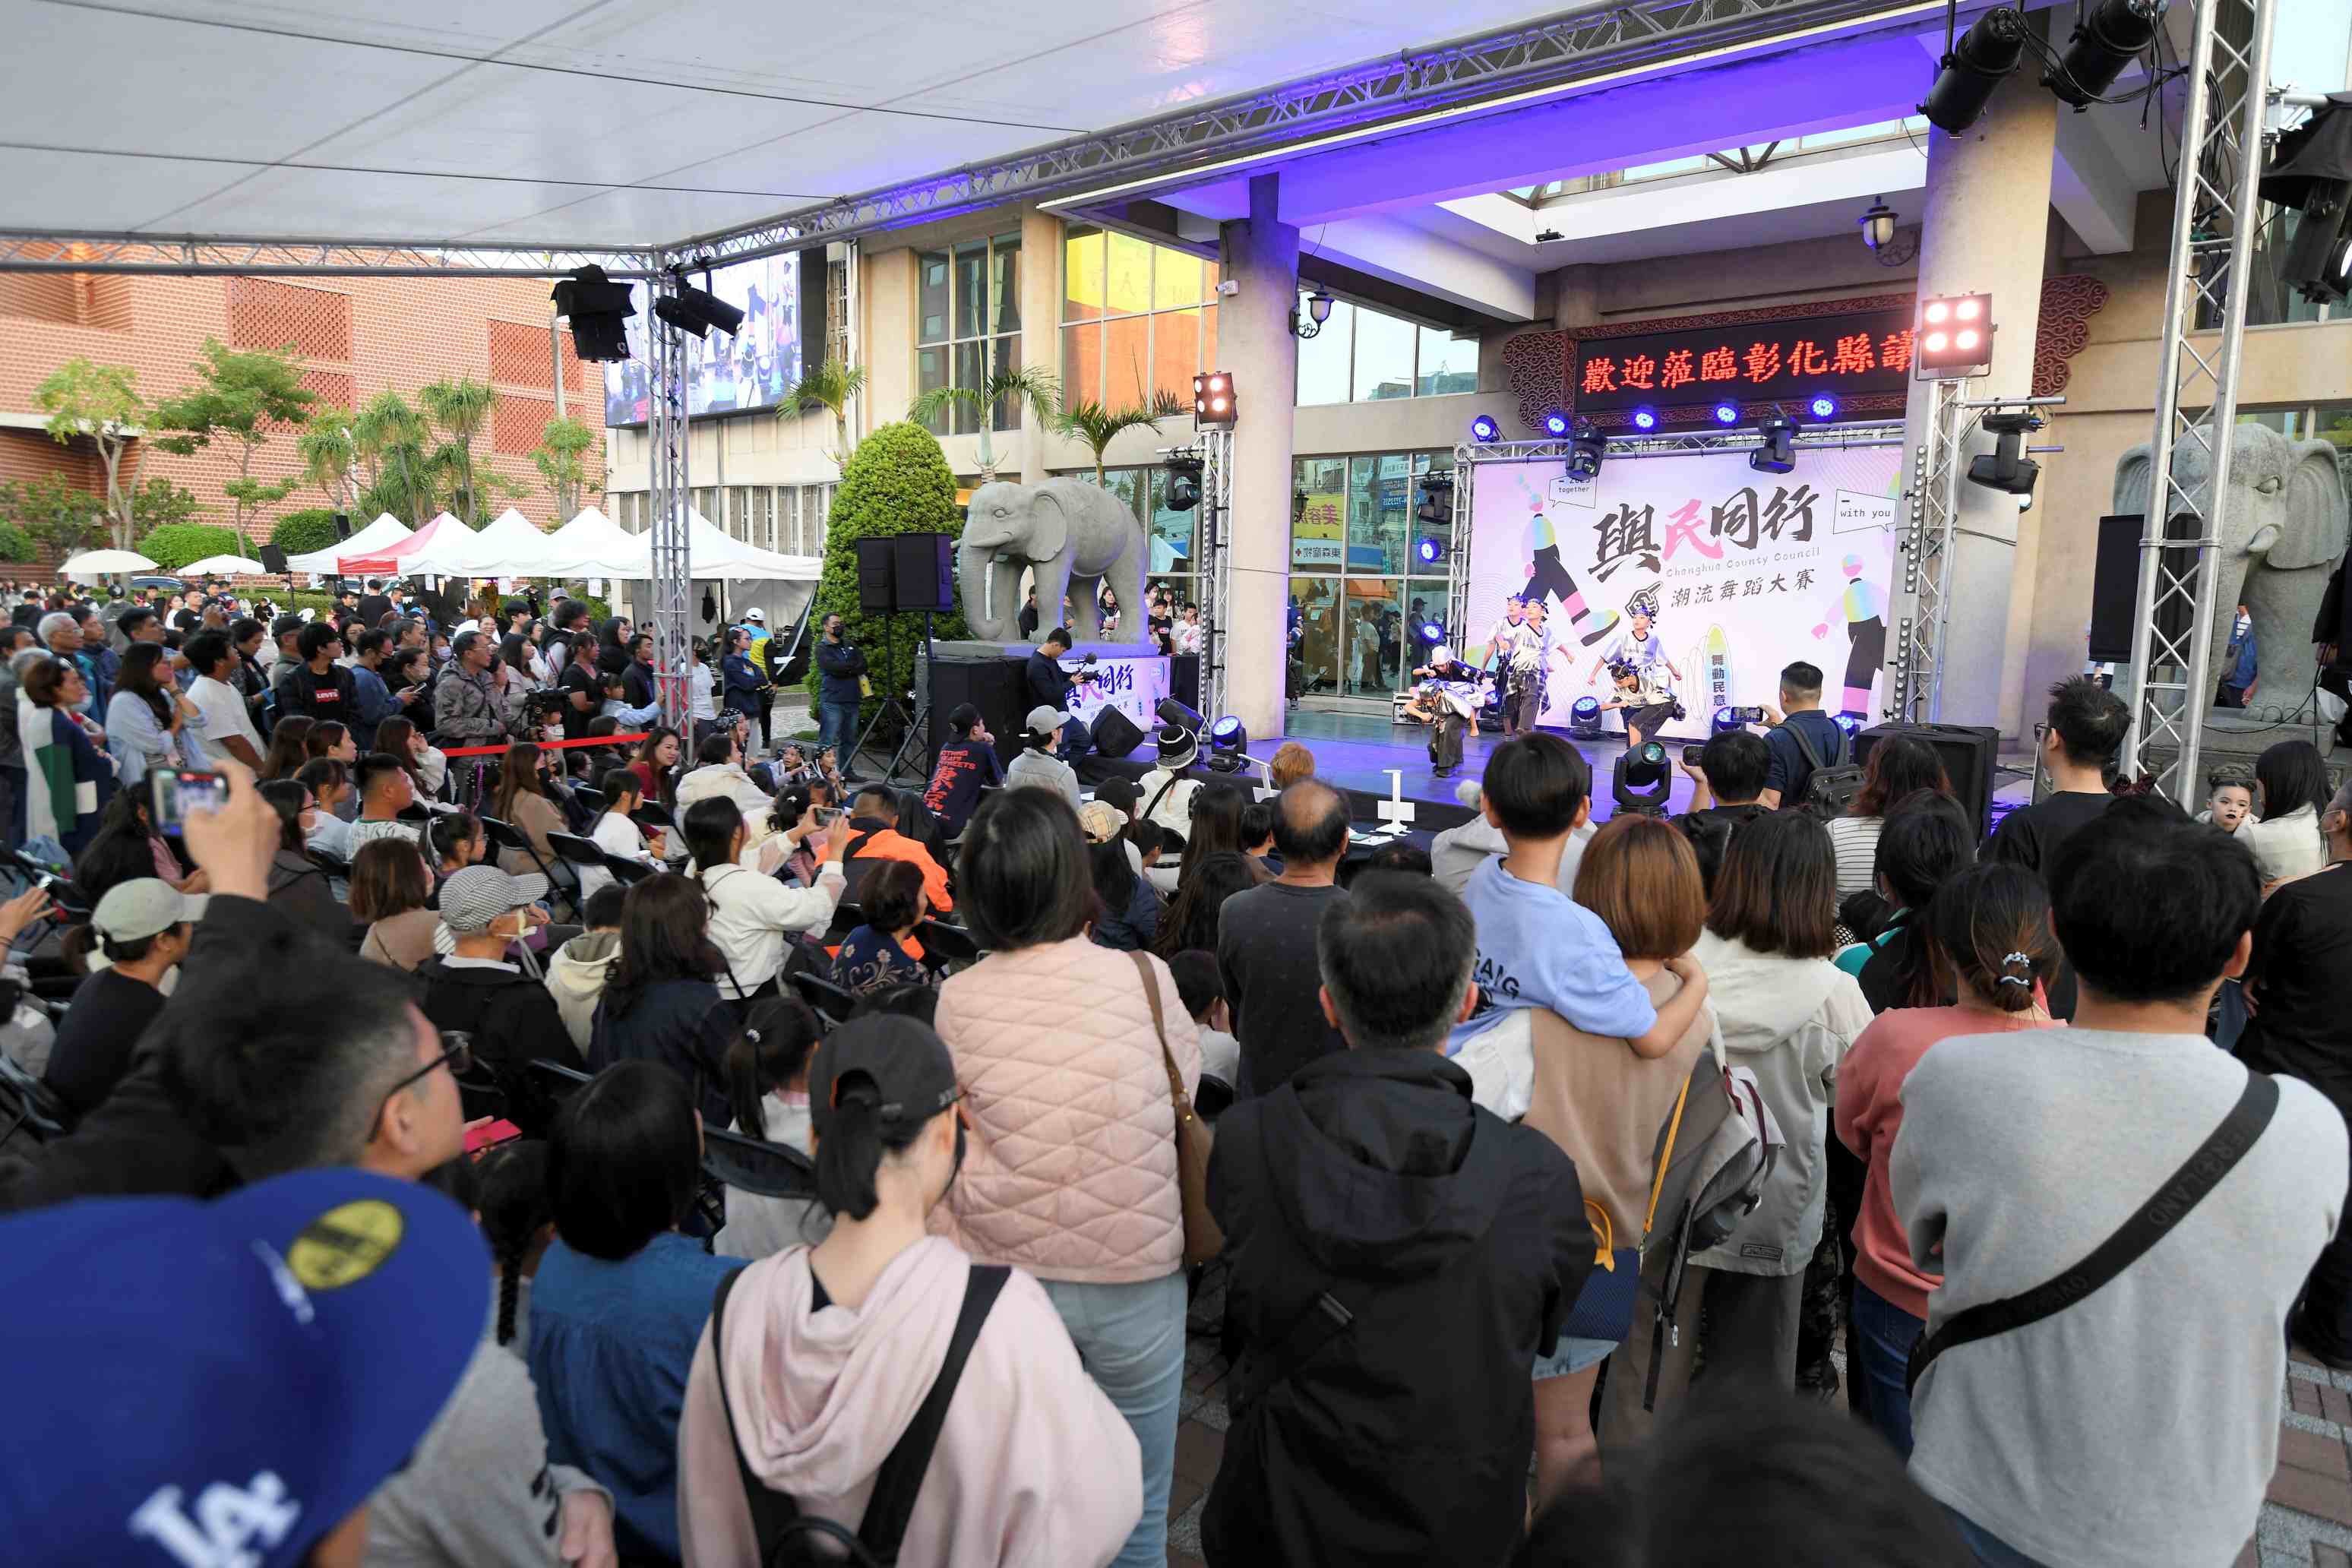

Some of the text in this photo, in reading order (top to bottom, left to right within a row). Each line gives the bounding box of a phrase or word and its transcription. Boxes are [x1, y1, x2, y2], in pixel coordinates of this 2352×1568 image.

[1840, 507, 1891, 519] with you
[1587, 485, 1819, 583] 與民同行
[1666, 546, 1820, 577] Changhua County Council
[1671, 567, 1816, 608] 潮流舞蹈大賽
